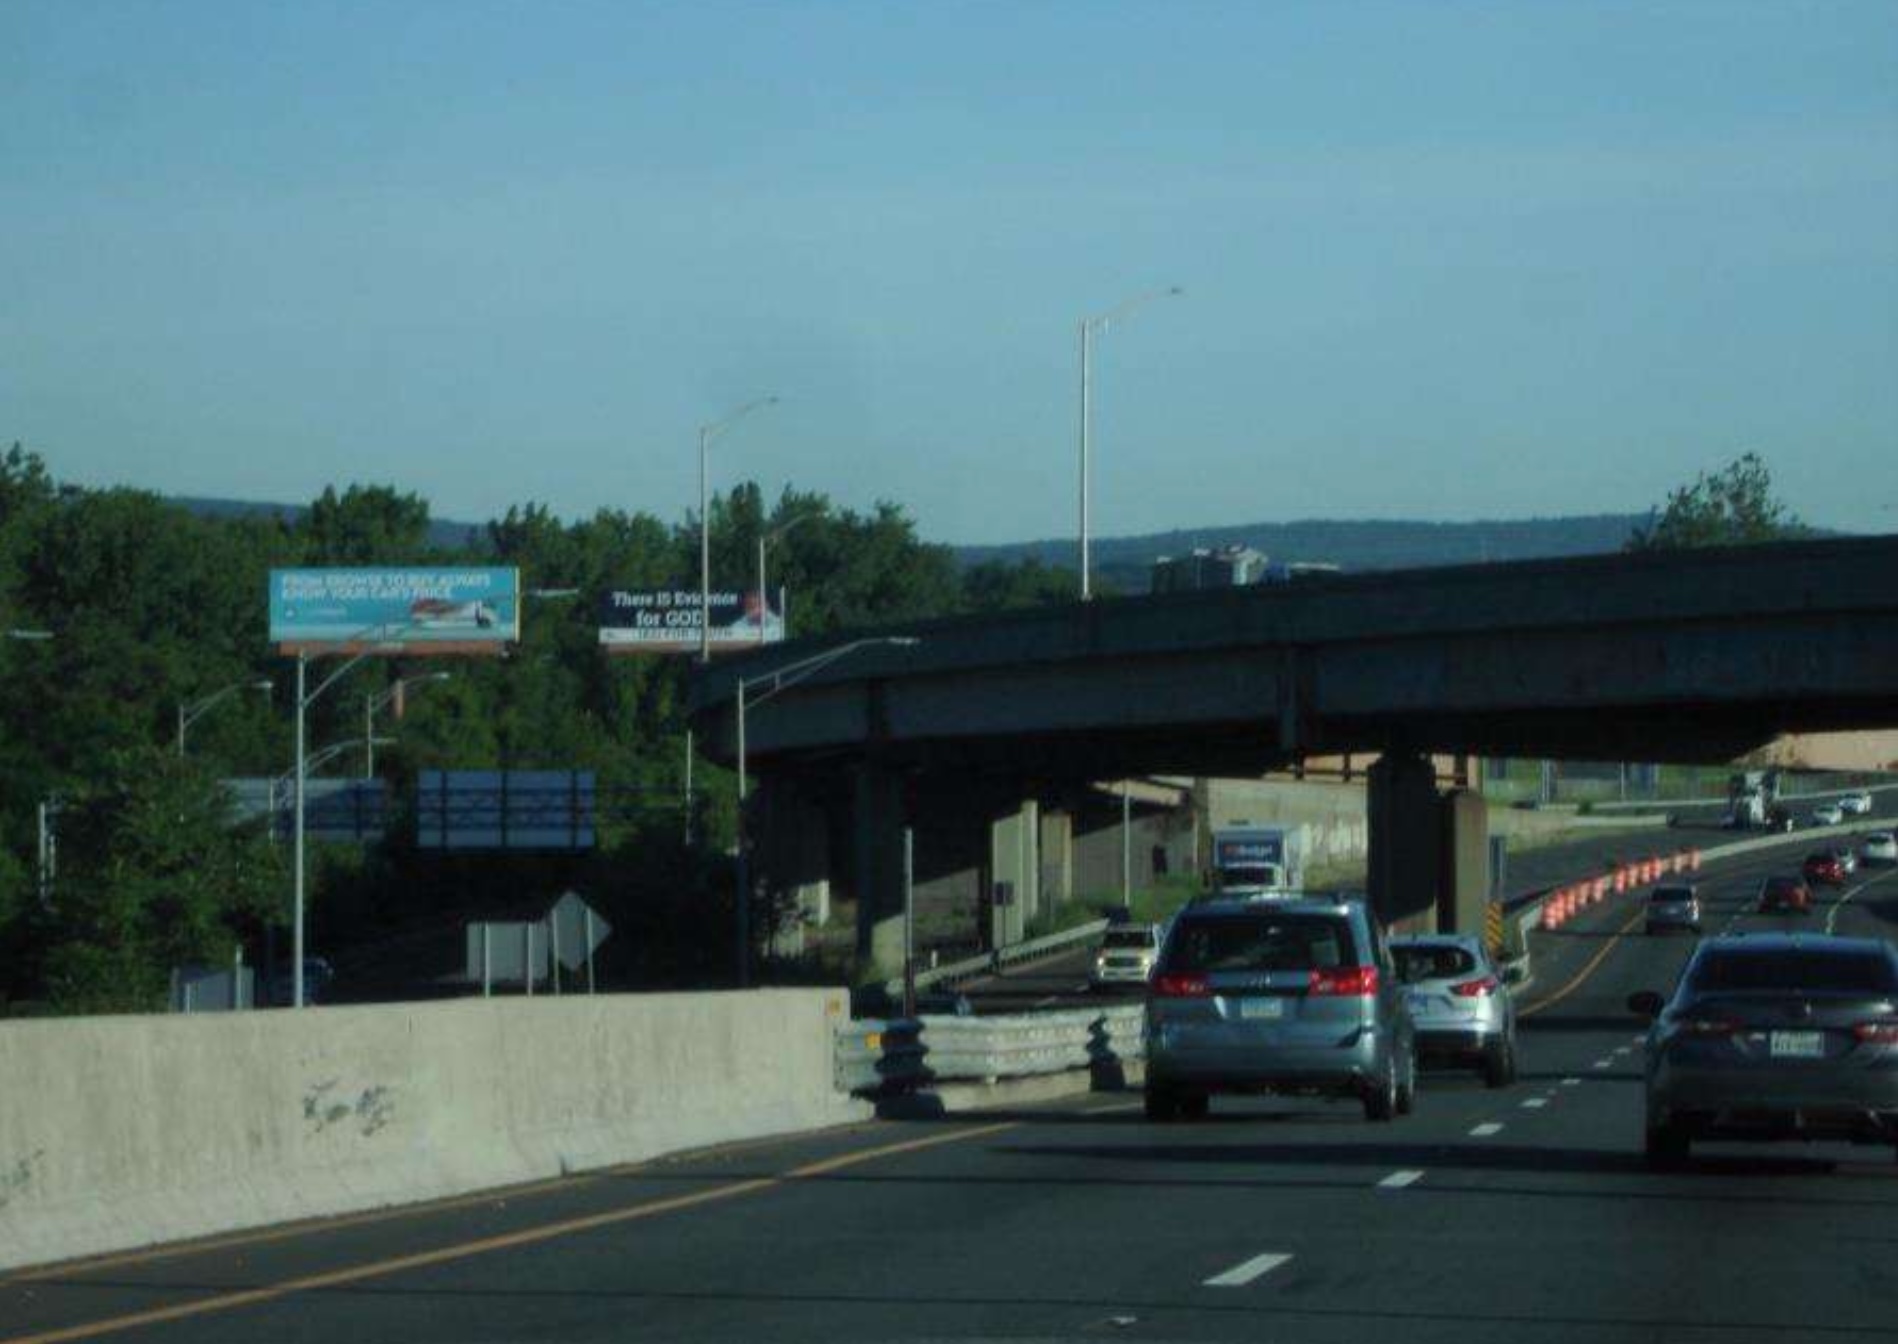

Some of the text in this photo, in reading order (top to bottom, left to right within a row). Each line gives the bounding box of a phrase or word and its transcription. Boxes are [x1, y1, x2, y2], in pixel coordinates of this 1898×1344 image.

[612, 591, 654, 607] There
[636, 608, 704, 627] for GOD
